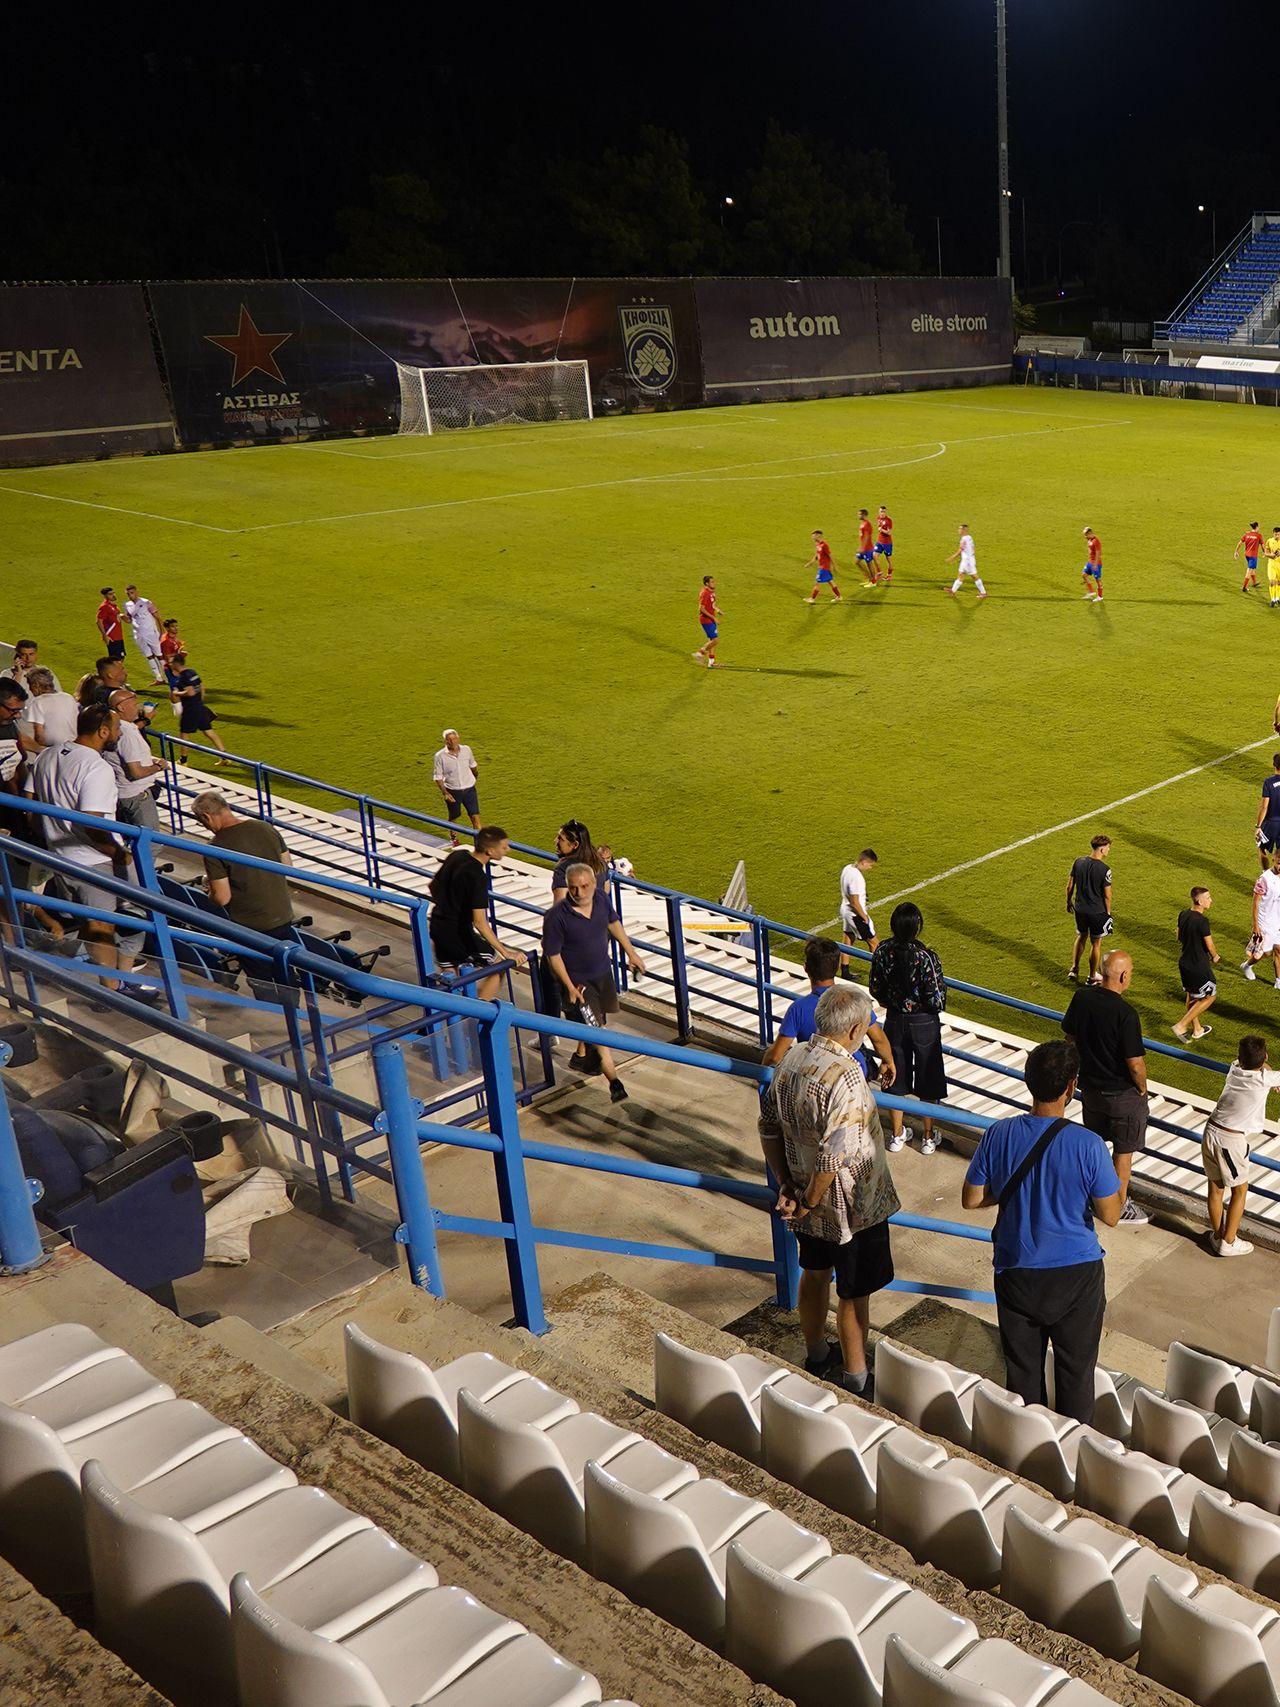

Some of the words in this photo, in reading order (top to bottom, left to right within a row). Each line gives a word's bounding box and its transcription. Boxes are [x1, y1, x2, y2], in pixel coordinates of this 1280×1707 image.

[623, 310, 670, 329] ΚΗΦΙΣΙΑ
[750, 312, 840, 339] autom
[911, 314, 943, 333] elite
[946, 313, 987, 331] strom
[222, 392, 302, 410] ΑΣΤΕΡΑΣ
